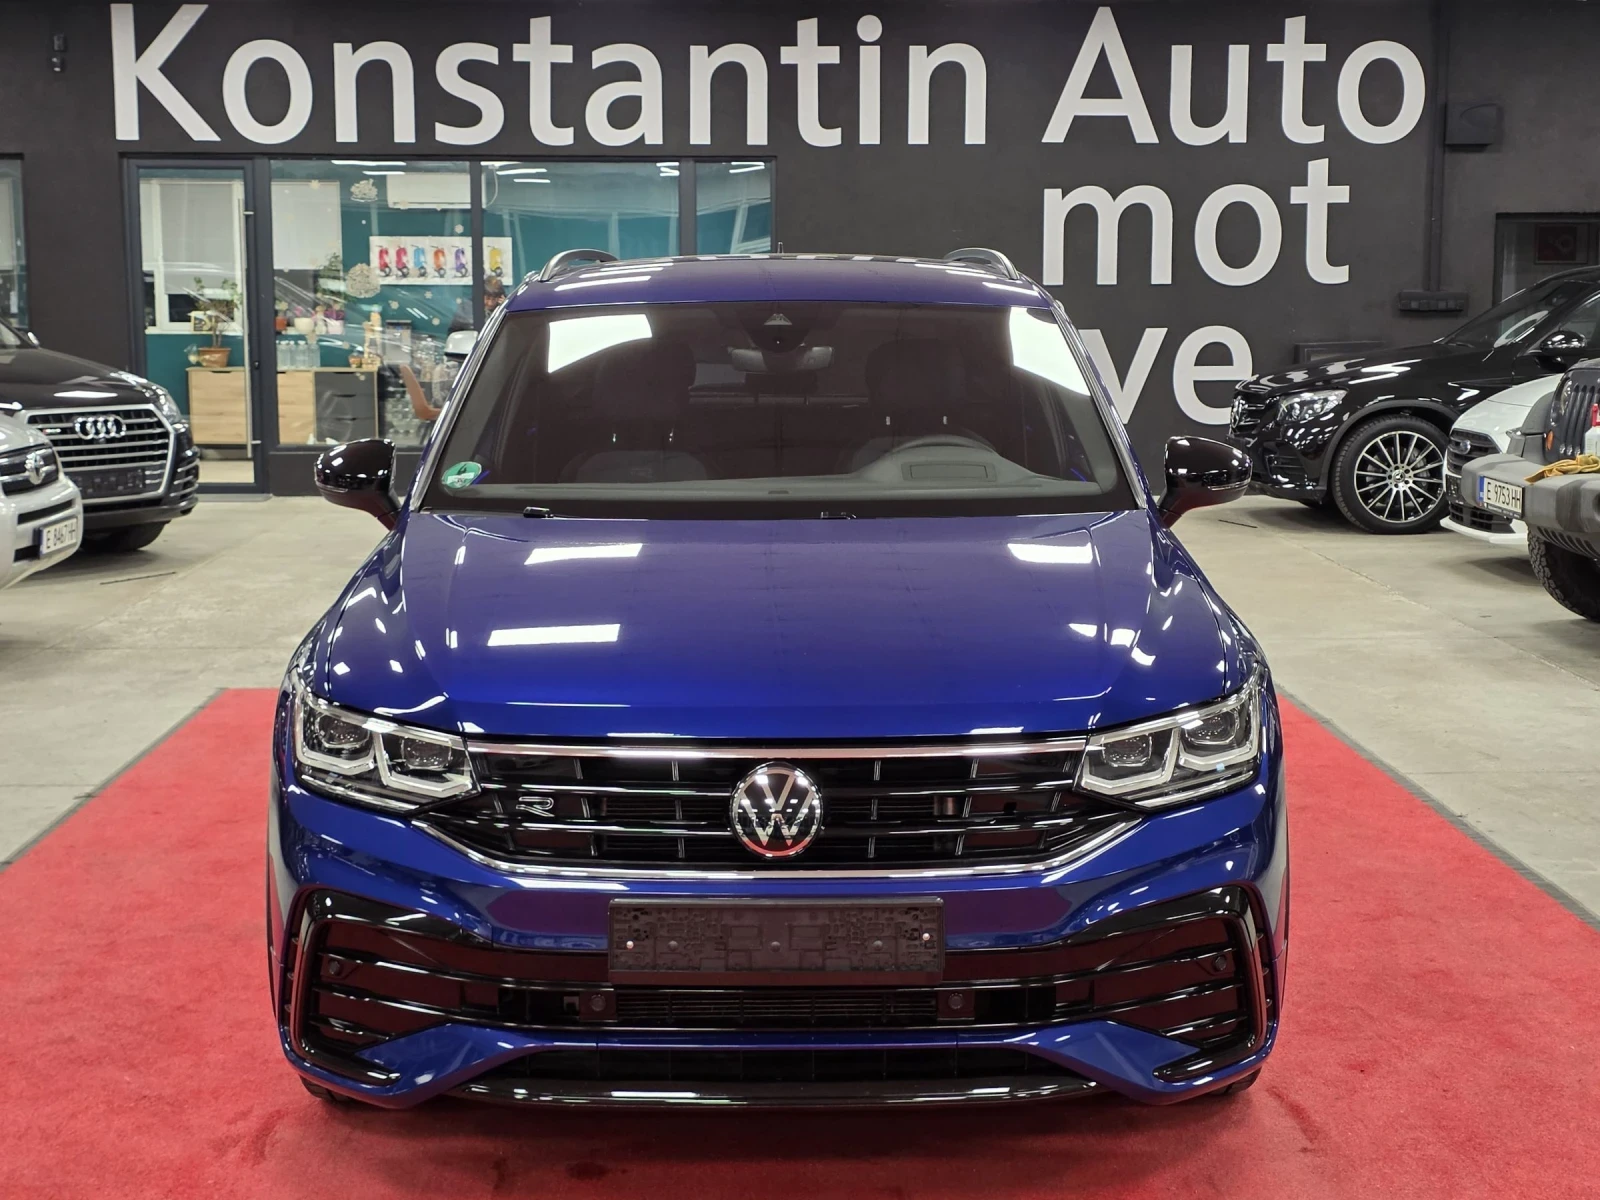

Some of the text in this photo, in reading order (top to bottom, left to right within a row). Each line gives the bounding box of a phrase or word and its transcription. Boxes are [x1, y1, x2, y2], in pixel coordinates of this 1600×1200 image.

[111, 4, 1426, 148] Konstantin Auto
[1042, 157, 1350, 287] mot
[1487, 482, 1491, 500] E
[47, 530, 51, 549] E
